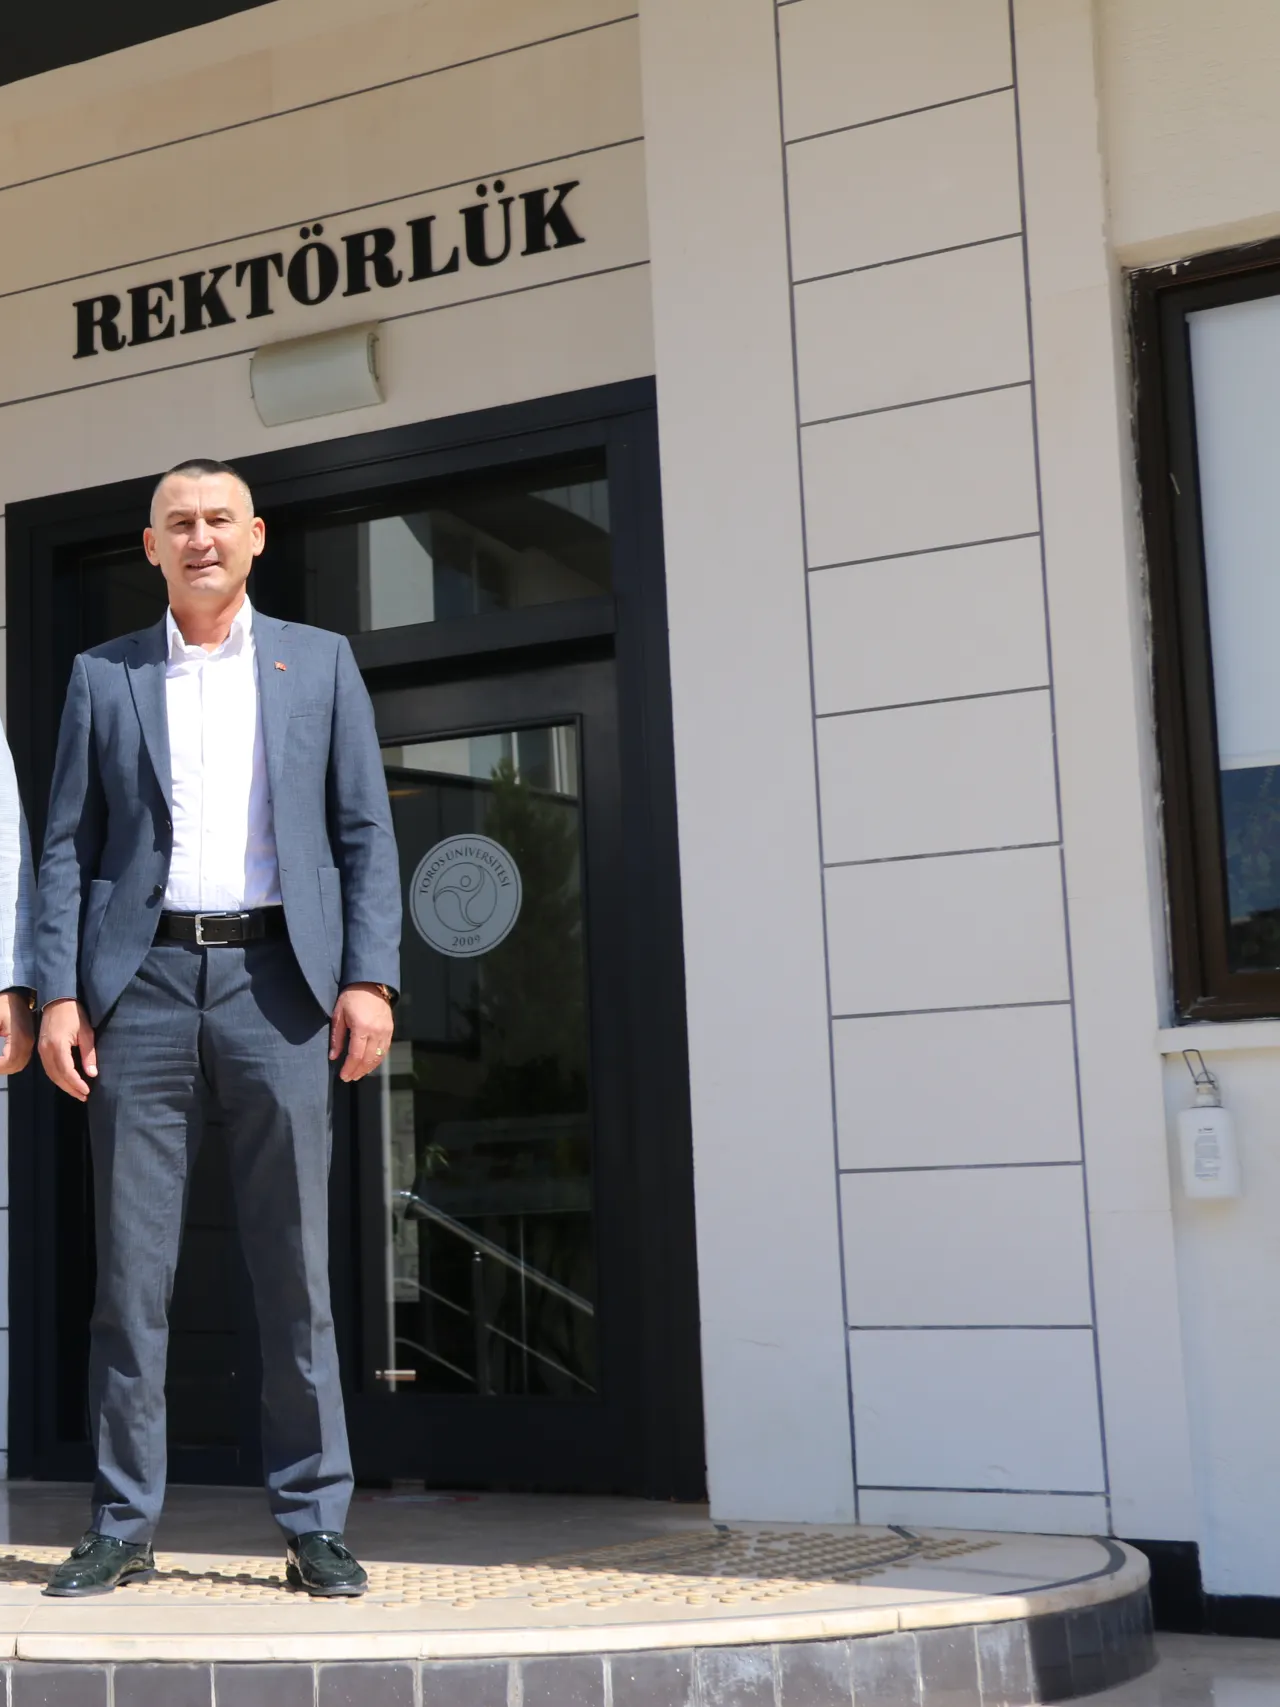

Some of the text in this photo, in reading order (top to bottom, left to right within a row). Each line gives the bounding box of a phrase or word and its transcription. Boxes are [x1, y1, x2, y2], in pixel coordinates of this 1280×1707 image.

[72, 180, 585, 359] REKTÖRLÜK
[420, 856, 445, 894] TOROS
[452, 934, 480, 946] 2009
